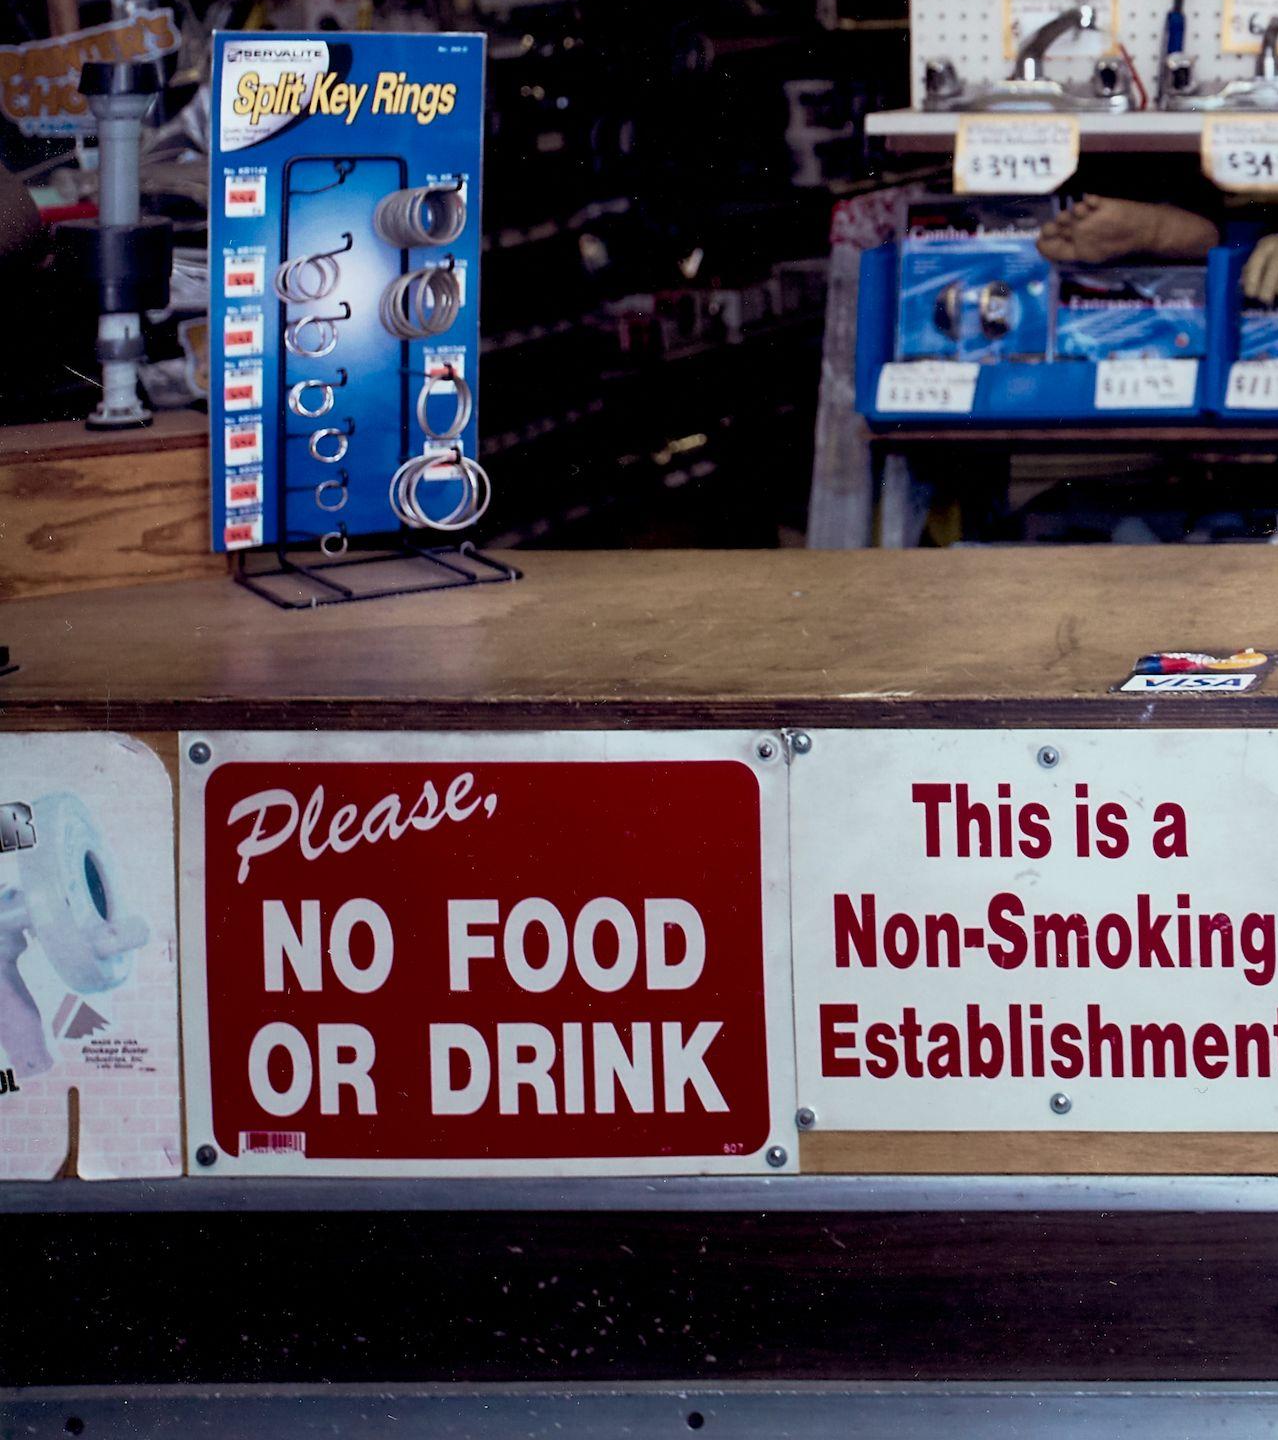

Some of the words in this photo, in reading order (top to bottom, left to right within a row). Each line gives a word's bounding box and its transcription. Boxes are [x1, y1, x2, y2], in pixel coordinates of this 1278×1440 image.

[243, 48, 323, 59] SERVALITE
[233, 71, 308, 126] Split
[308, 71, 369, 126] Key
[371, 71, 459, 126] Rings
[1145, 677, 1242, 688] VISA
[227, 770, 500, 885] Please,
[911, 781, 1054, 860] This
[1074, 781, 1130, 860] is
[1151, 800, 1189, 860] a
[262, 897, 396, 994] NO
[446, 896, 708, 994] FOOD
[831, 890, 1278, 987] Non-Smoking
[247, 1021, 379, 1117] OR
[428, 1020, 731, 1117] DRINK
